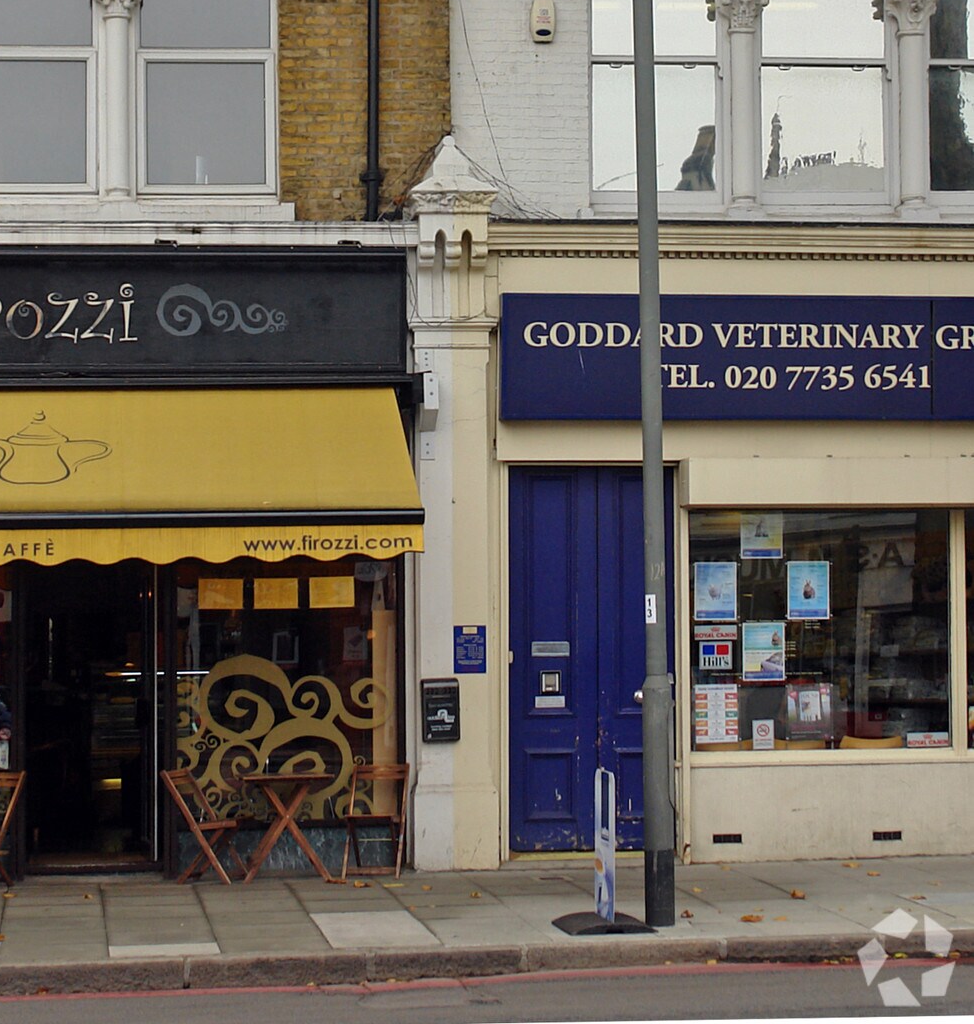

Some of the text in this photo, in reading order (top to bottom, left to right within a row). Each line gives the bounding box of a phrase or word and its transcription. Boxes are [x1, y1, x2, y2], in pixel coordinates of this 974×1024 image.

[712, 323, 925, 349] VETERINARY
[724, 365, 777, 390] 020
[785, 365, 855, 391] 7735
[864, 363, 931, 391] 6541
[243, 534, 414, 553] www.firozzi.com
[702, 656, 730, 667] Hill's
